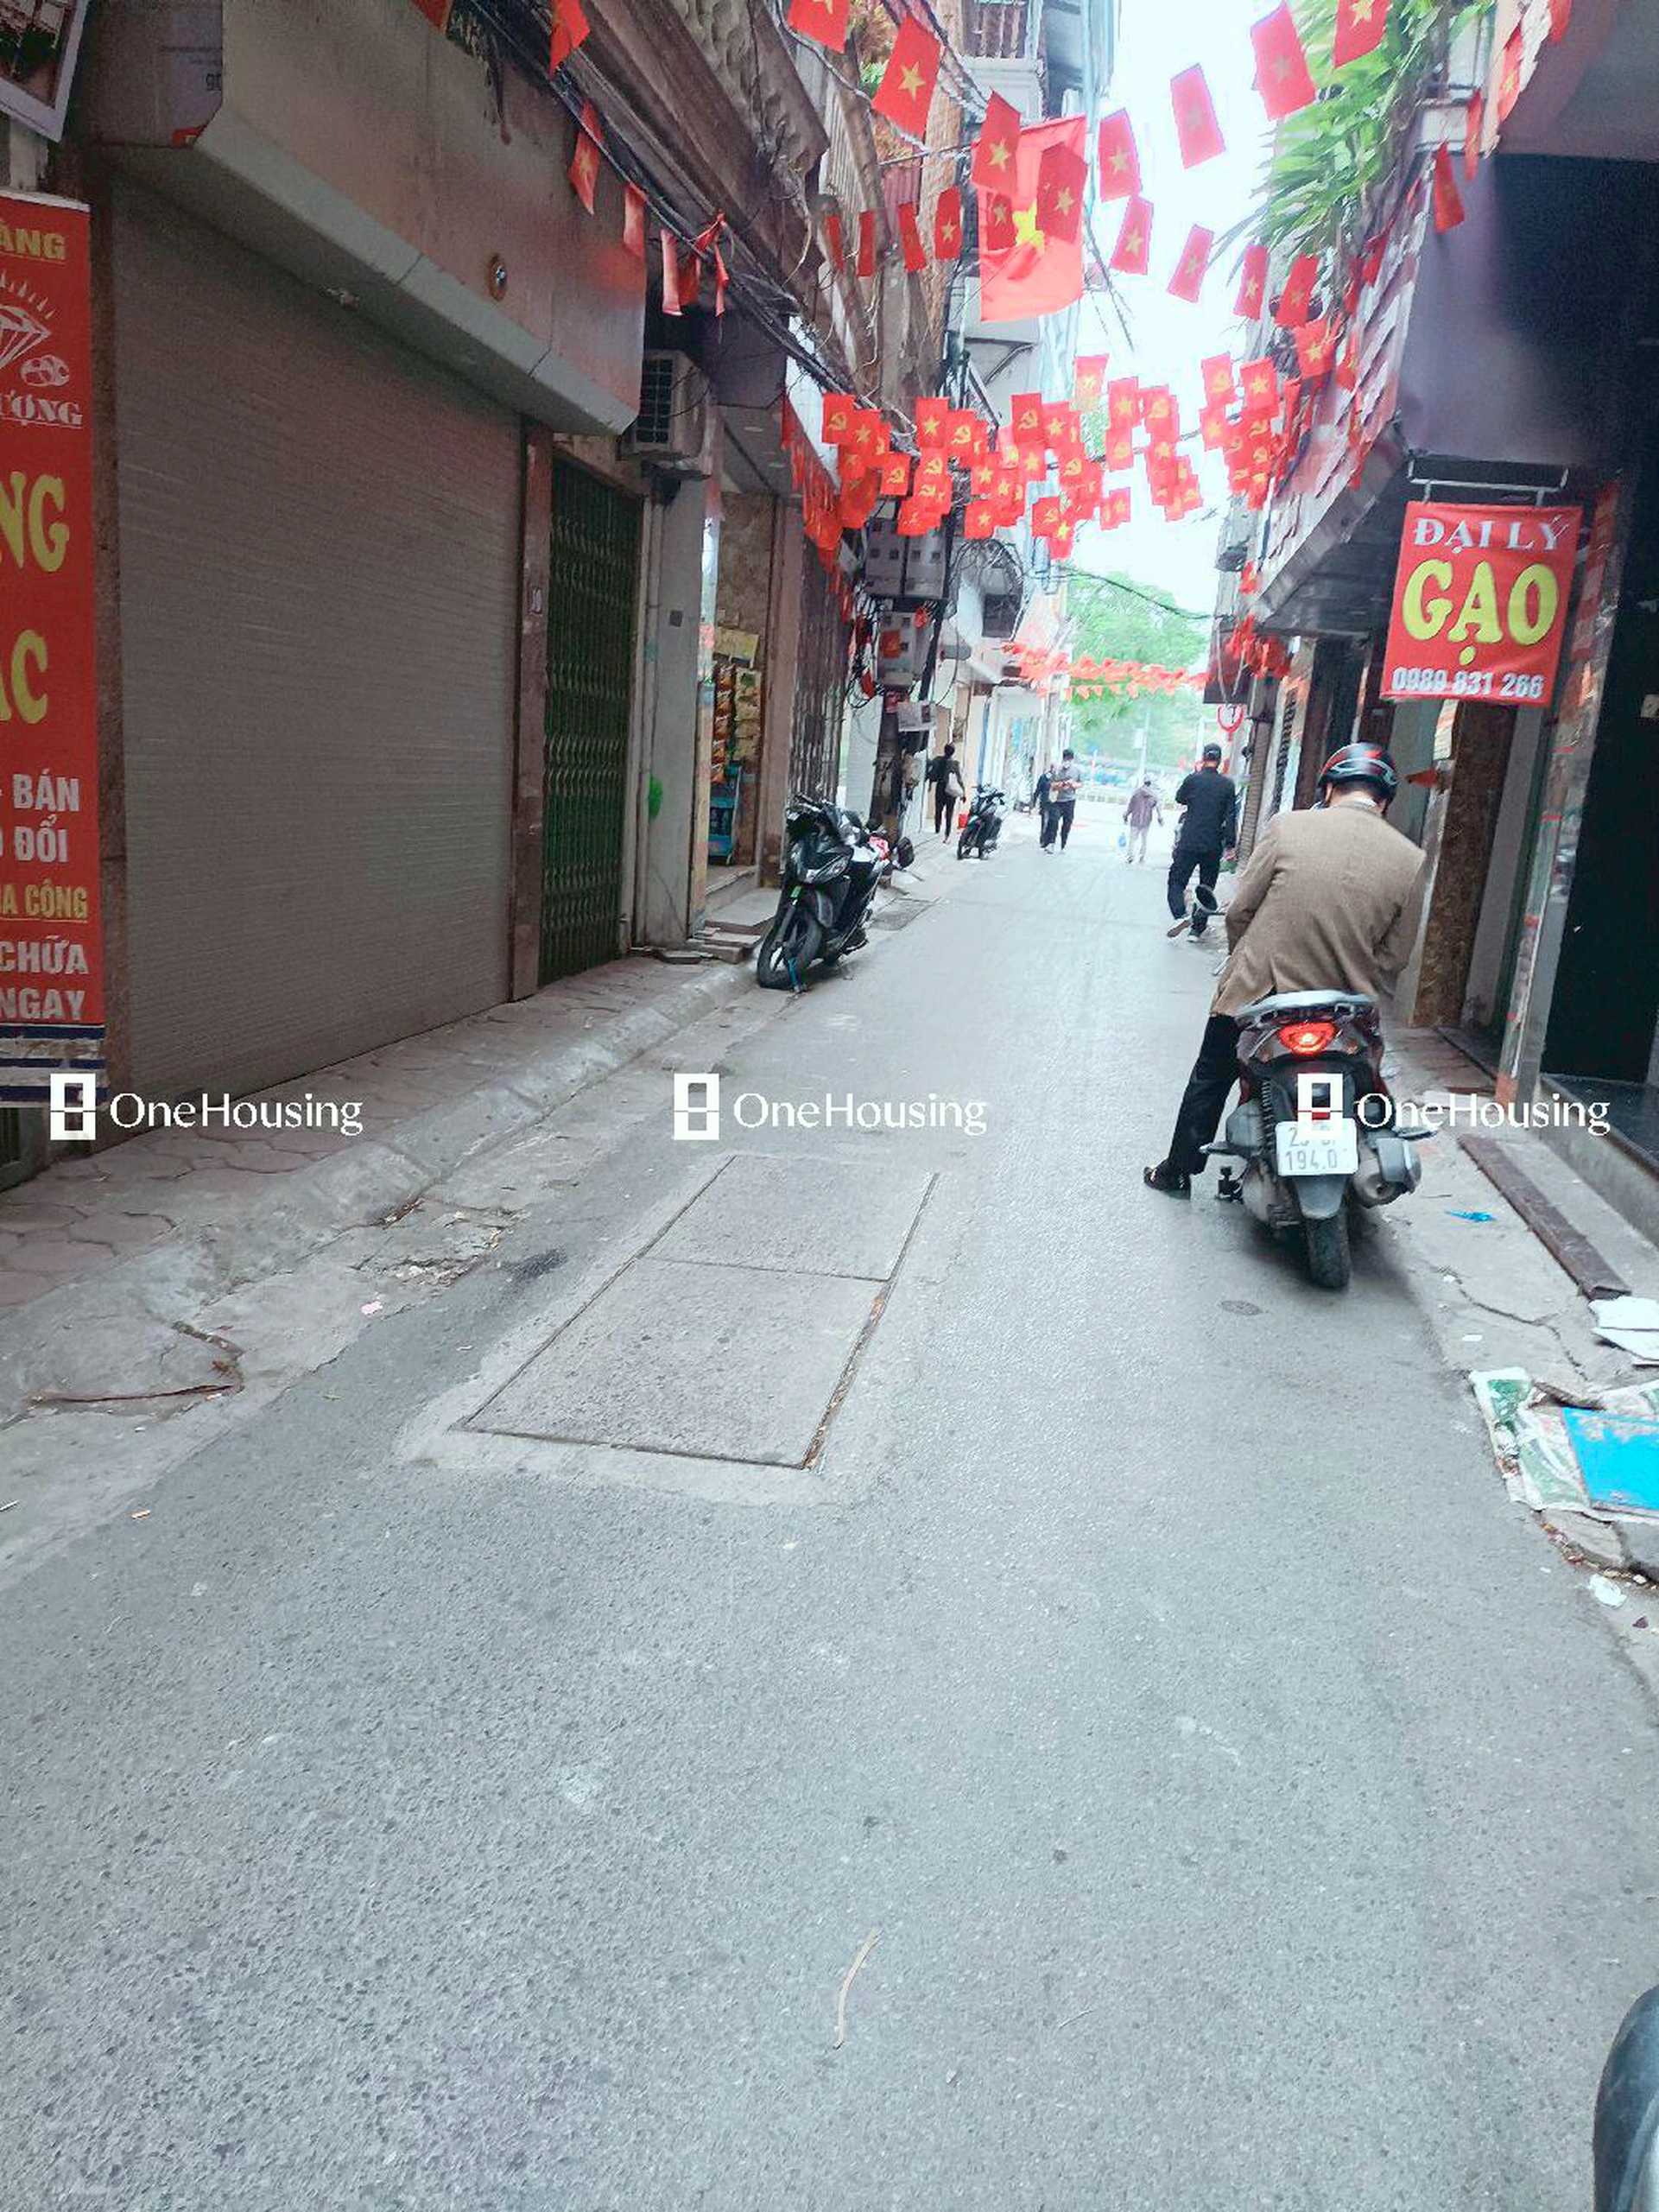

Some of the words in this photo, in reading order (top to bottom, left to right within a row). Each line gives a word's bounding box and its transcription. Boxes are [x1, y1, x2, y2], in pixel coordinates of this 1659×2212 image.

[1413, 517, 1496, 555] ĐẠI
[1508, 515, 1569, 551] LÝ
[1403, 559, 1560, 665] GẠO
[13, 768, 80, 812] BÁN
[14, 814, 69, 862] ĐỔI
[24, 878, 88, 918] CÔNG
[0, 935, 89, 975] CHỮA
[0, 987, 85, 1021] NGAY
